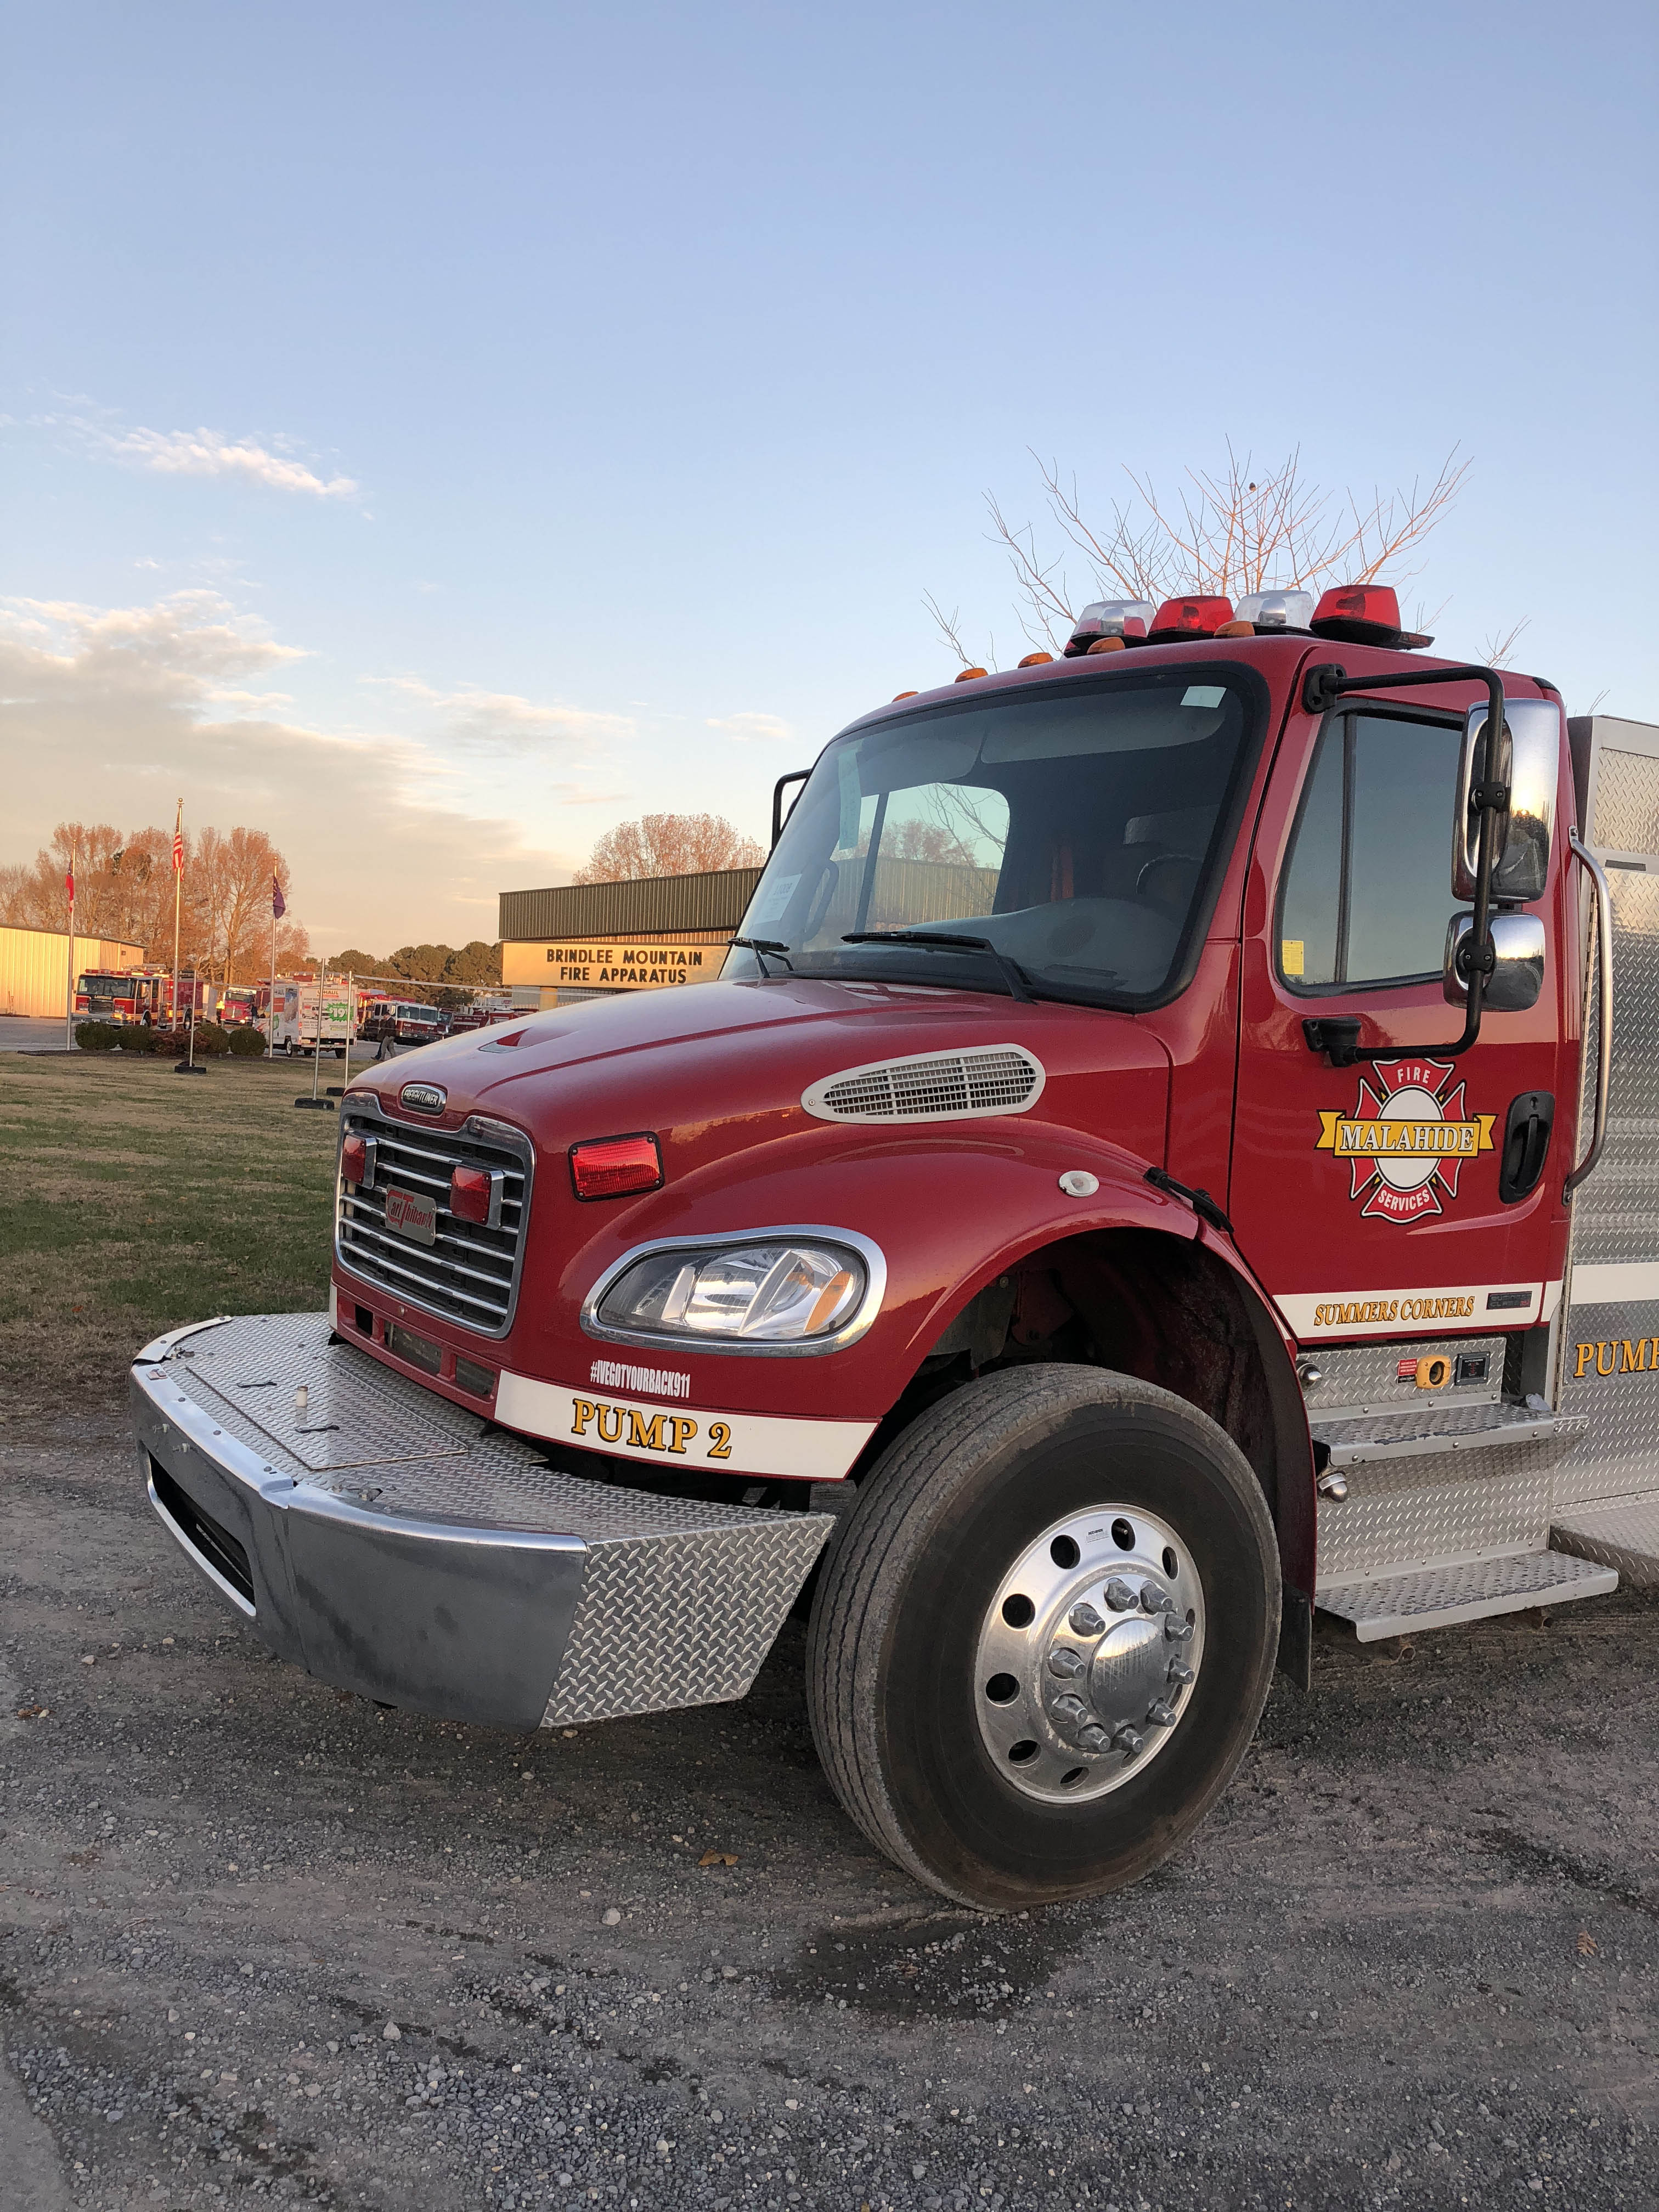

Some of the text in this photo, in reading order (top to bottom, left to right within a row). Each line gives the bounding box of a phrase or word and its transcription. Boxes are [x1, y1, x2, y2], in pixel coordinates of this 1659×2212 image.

[546, 949, 703, 966] BRINDLEE MOUNTAIN
[560, 966, 687, 984] FIRE APPARATUS
[1396, 1066, 1432, 1084] FIRE
[404, 1089, 439, 1105] FREIGHTLINER
[1340, 1124, 1475, 1152] MALAHIDE
[1377, 1188, 1430, 1211] SERVICES
[1313, 1295, 1476, 1327] SUMMERS CORNERS
[590, 1359, 691, 1398] #IVEGOTYOURBACK911
[571, 1397, 732, 1459] PUMP 2
